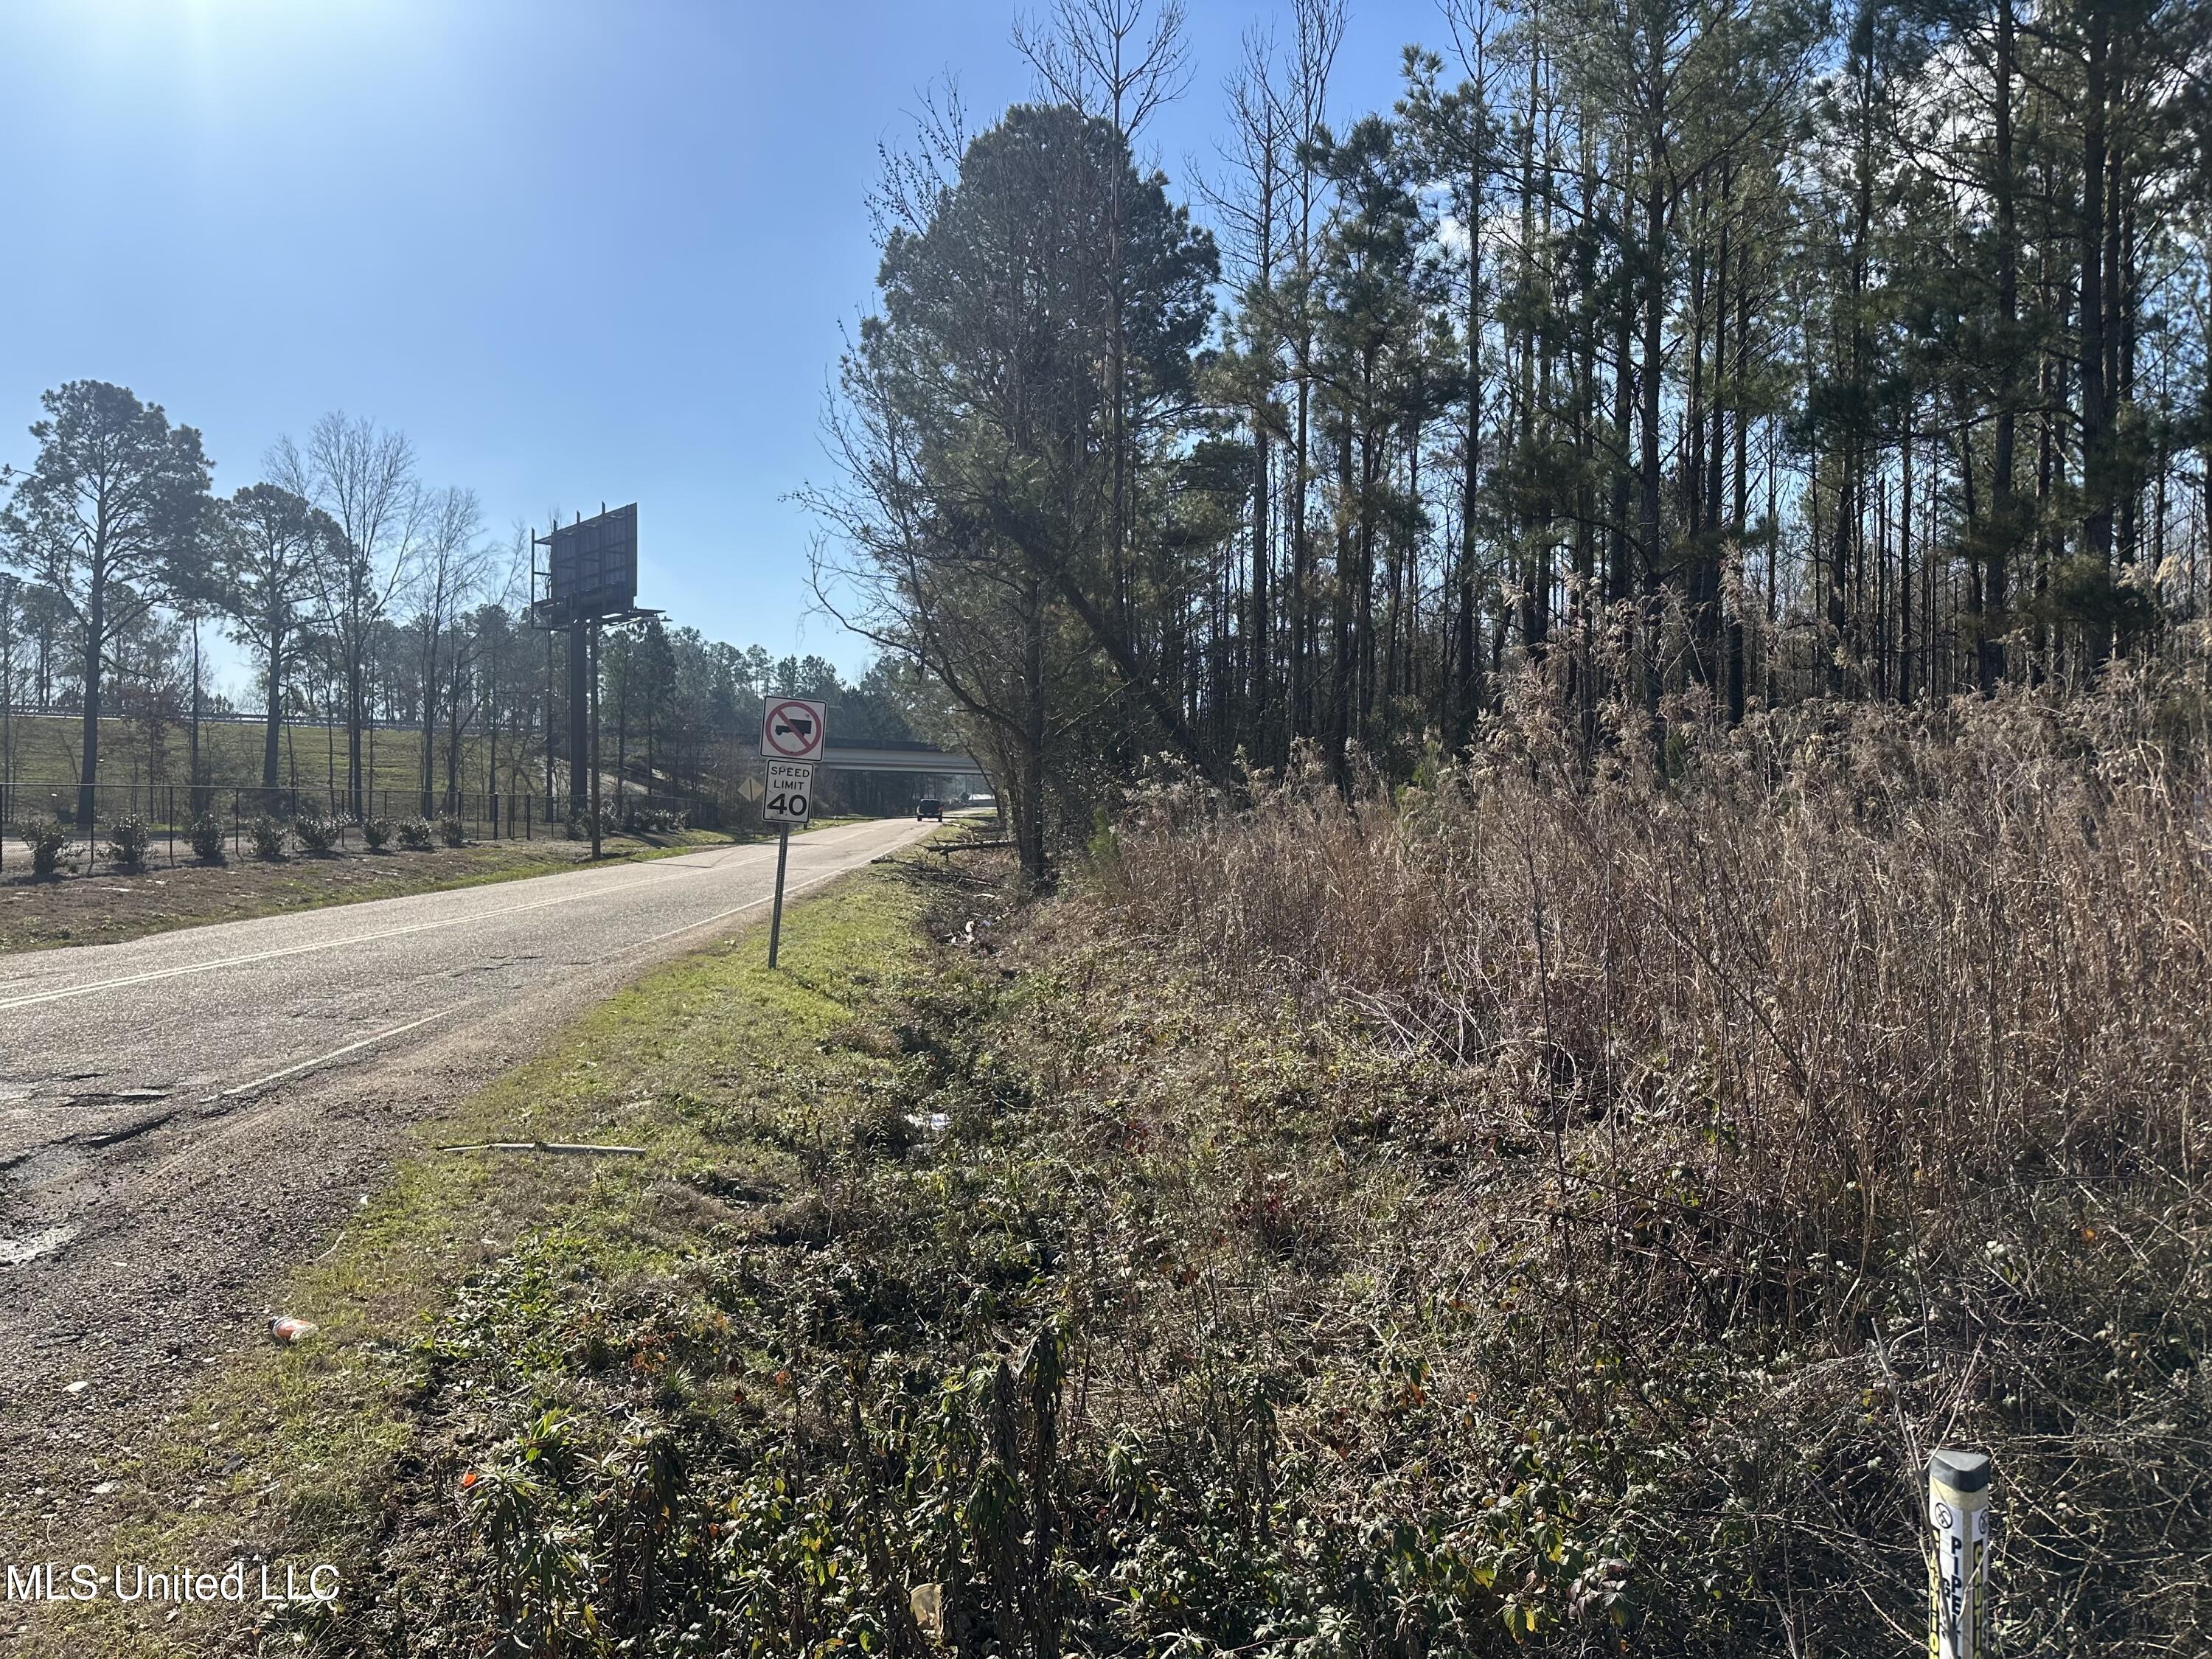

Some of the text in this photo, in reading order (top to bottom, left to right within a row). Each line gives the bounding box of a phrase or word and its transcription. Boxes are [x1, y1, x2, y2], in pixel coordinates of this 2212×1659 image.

[771, 766, 810, 778] SPEED
[773, 779, 804, 790] LIMIT
[766, 793, 807, 816] 40
